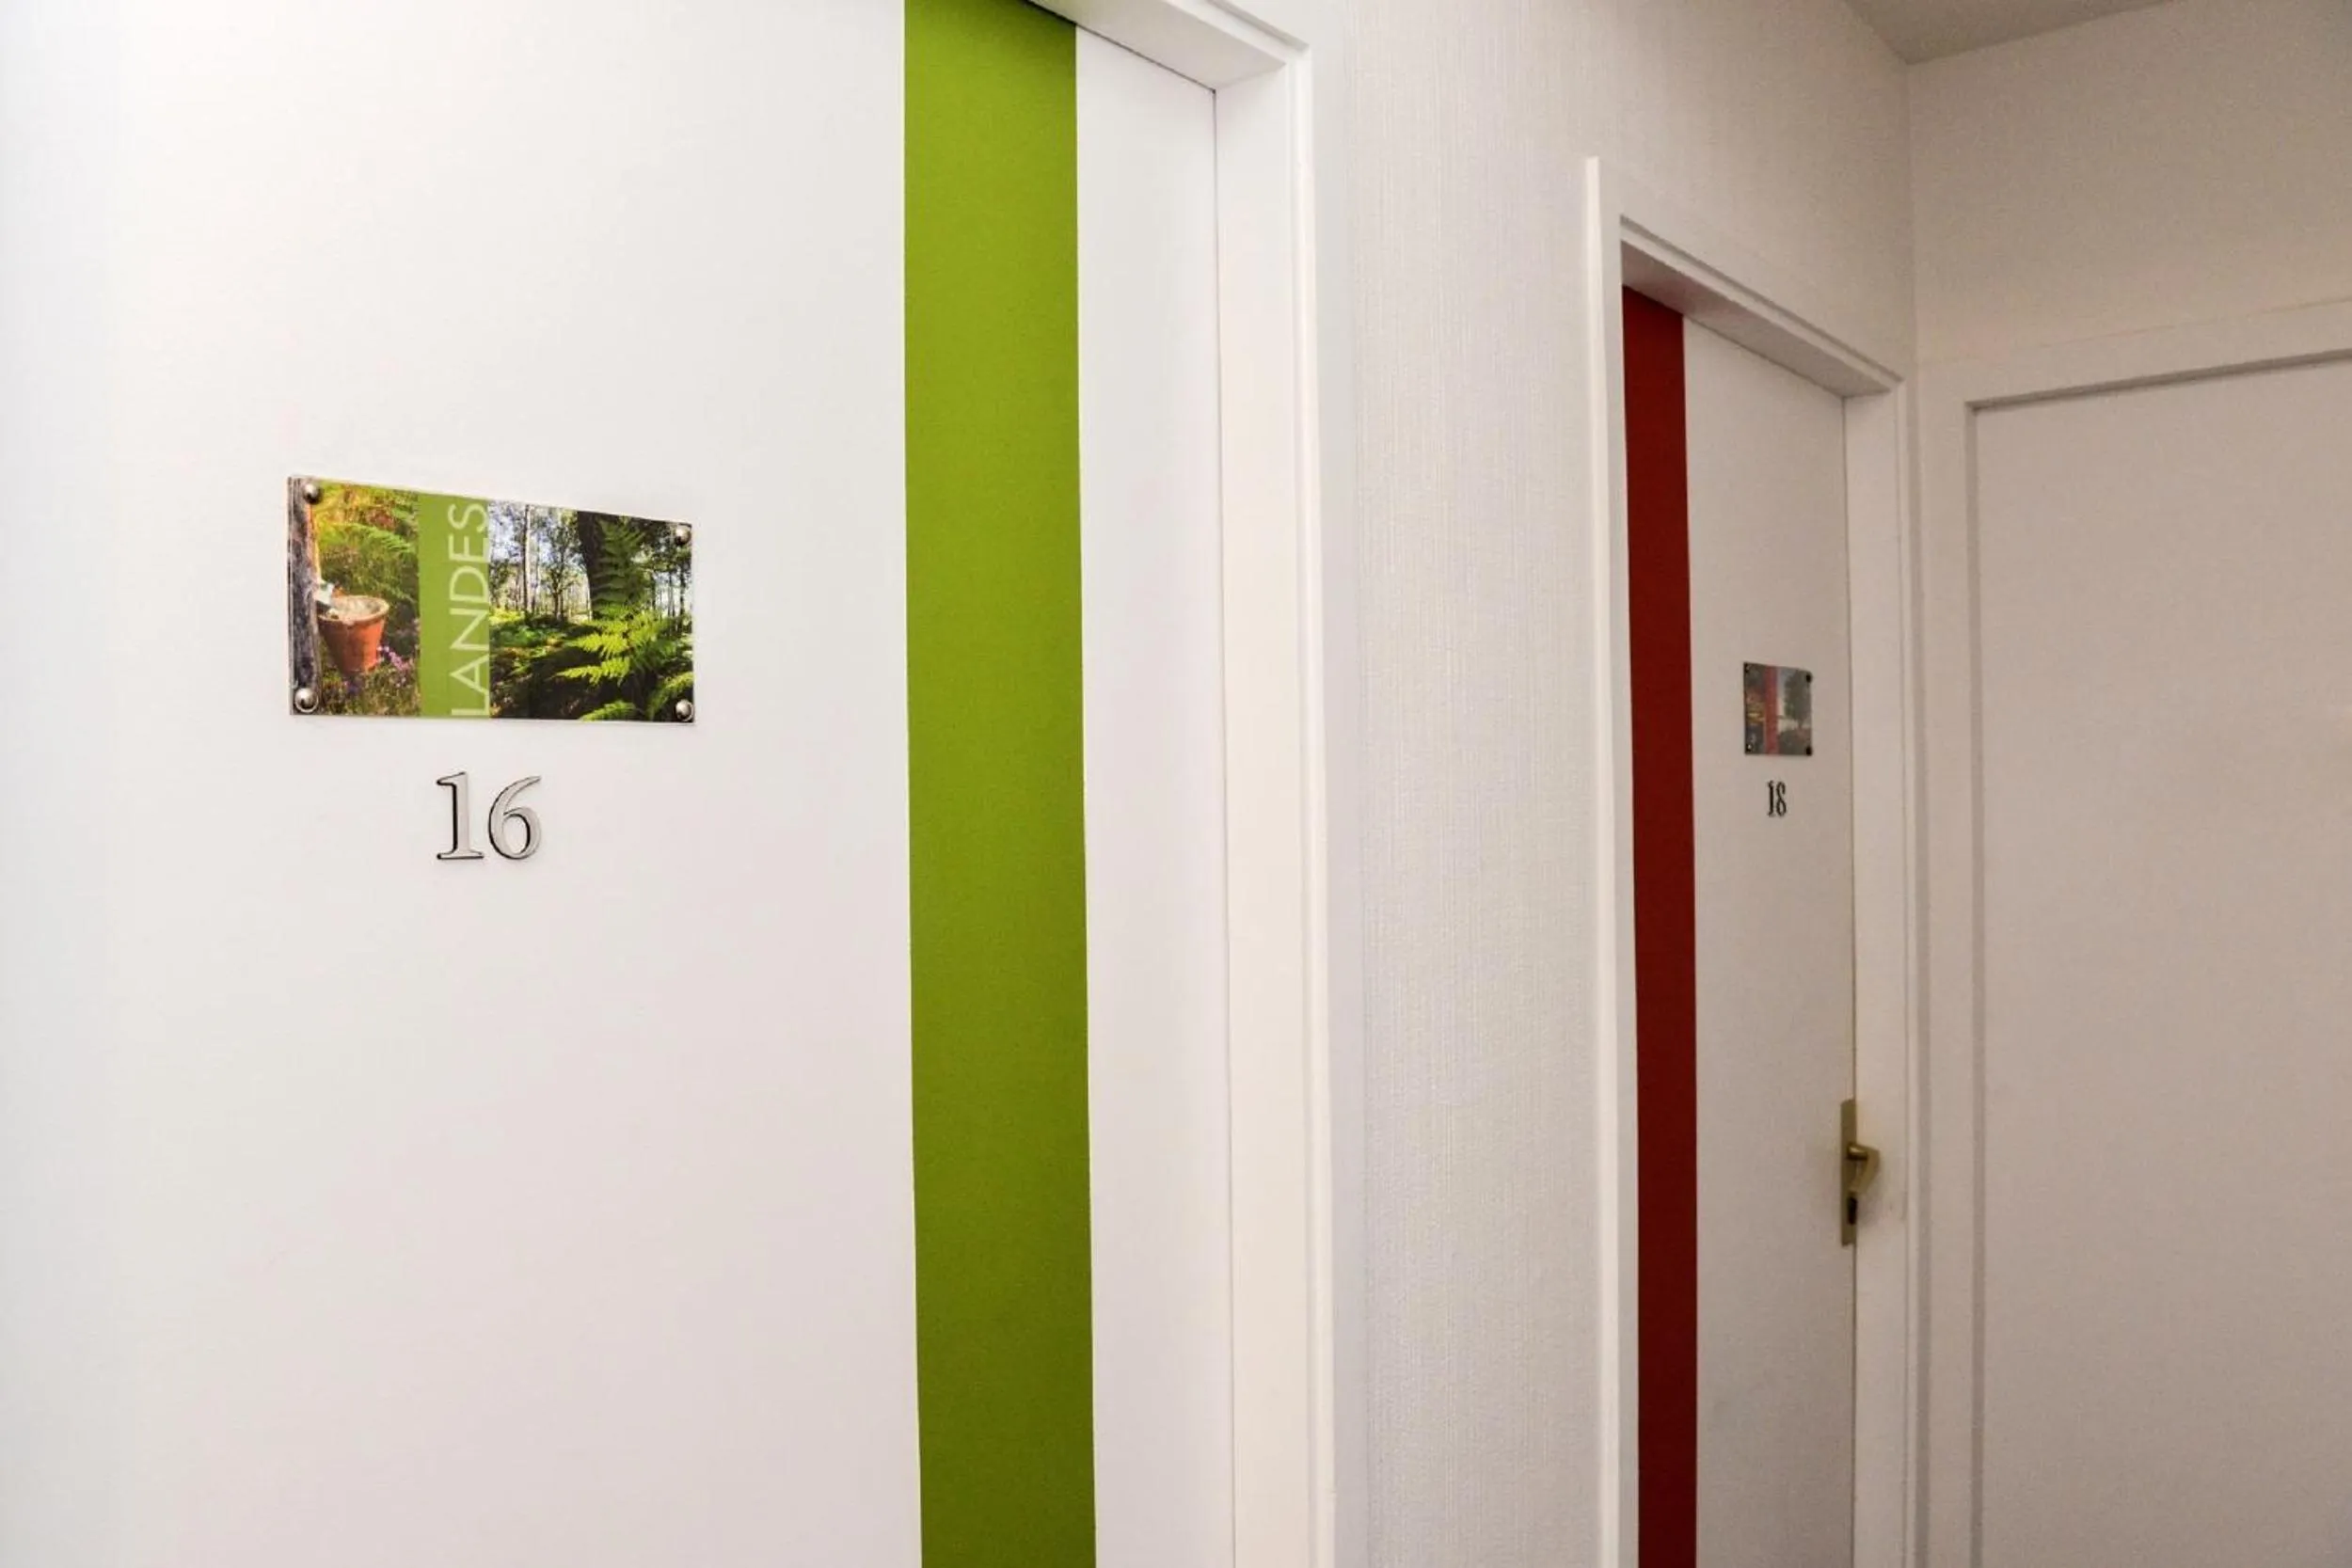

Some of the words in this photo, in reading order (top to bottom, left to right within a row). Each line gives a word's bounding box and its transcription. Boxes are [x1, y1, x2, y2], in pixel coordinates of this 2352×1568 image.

[448, 502, 490, 717] LANDES
[436, 771, 543, 860] 16
[1767, 780, 1787, 817] 18
